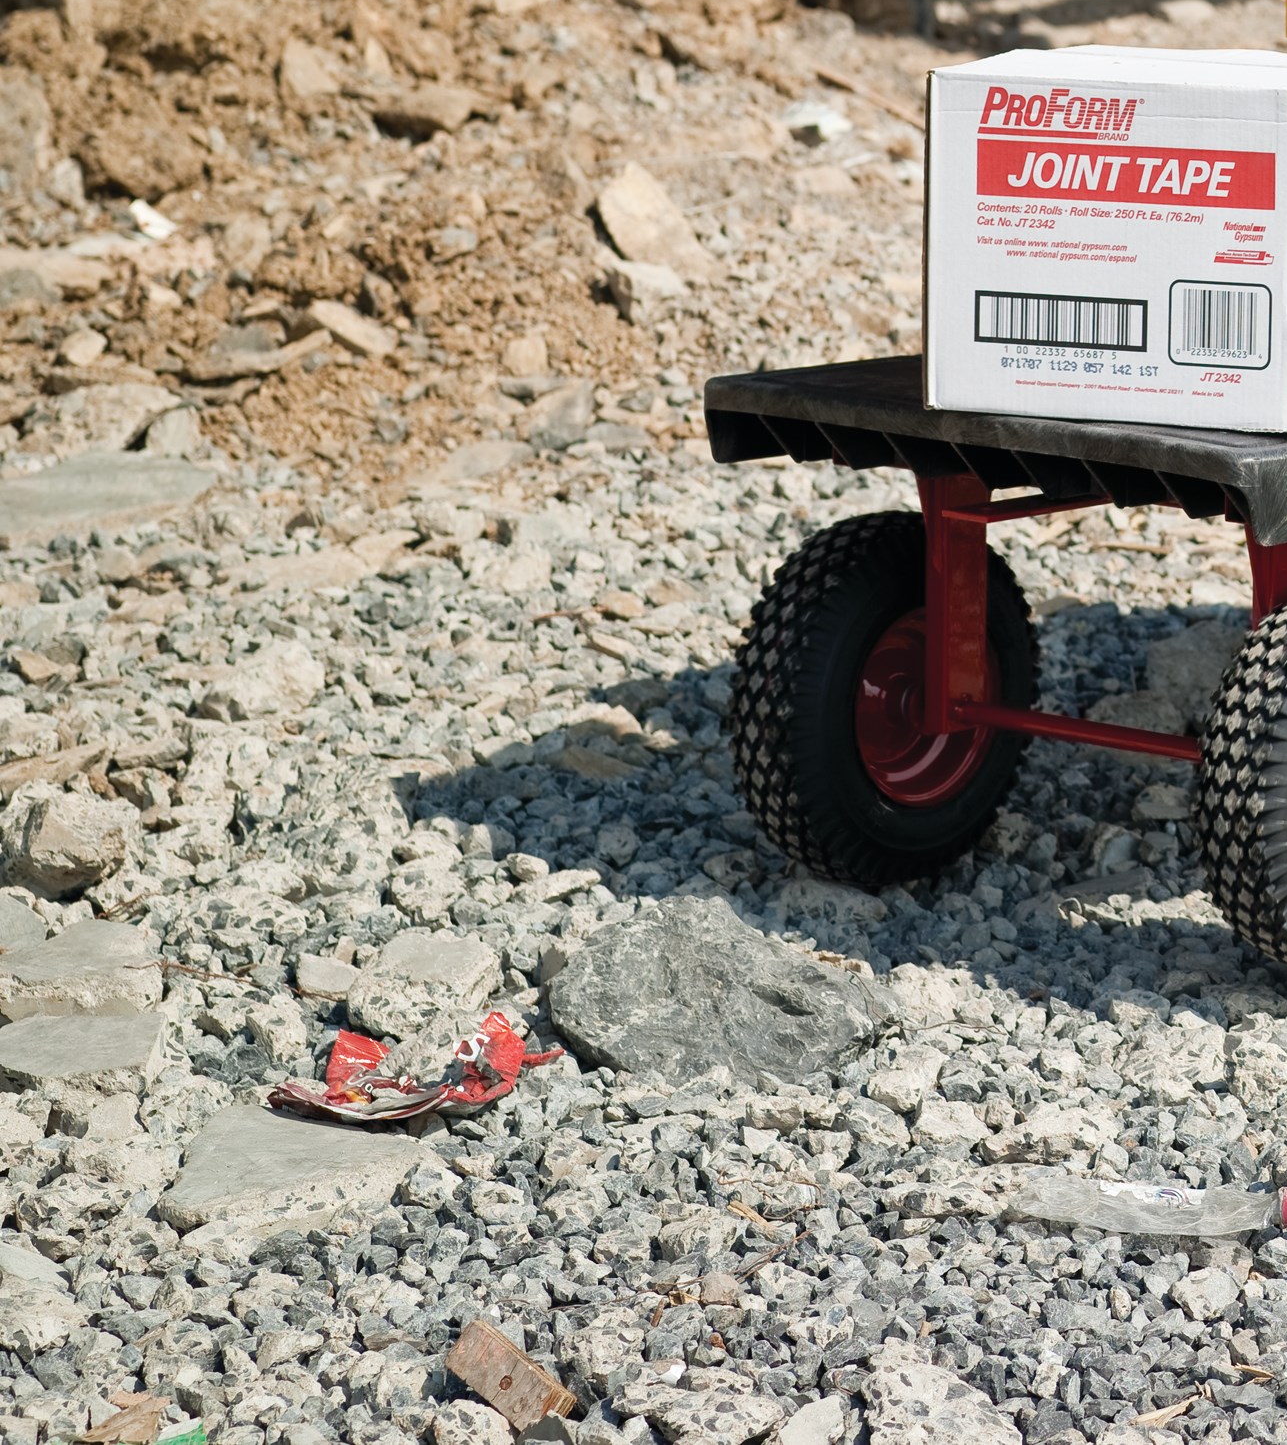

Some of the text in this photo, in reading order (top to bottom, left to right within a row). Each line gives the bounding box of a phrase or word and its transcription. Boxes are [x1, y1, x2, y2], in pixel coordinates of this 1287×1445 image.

[1098, 132, 1129, 142] BRAND
[1007, 151, 1235, 197] JOINT TAPE
[977, 202, 1204, 225] Contents: 20 Rolls Roll Size: 250 Ft. Ea. (76.2m)
[977, 216, 995, 226] Cat.
[998, 217, 1012, 226] No.
[1223, 221, 1254, 232] National
[976, 235, 993, 245] Visit
[1004, 237, 1027, 247] online
[1027, 240, 1049, 248] www.
[1050, 239, 1081, 249] national
[1081, 242, 1128, 252] gypsum.com
[1234, 231, 1264, 243] Gypsum
[1028, 249, 1059, 259] national
[1059, 251, 1138, 264] gypsum.com/espanol
[1004, 346, 1117, 360] 1 00 22332 65687 5
[1191, 348, 1218, 357] 22332
[1220, 350, 1248, 359] 29623
[1050, 359, 1078, 372] 1129
[1111, 364, 1132, 376] 142
[1139, 365, 1159, 377] 1ST
